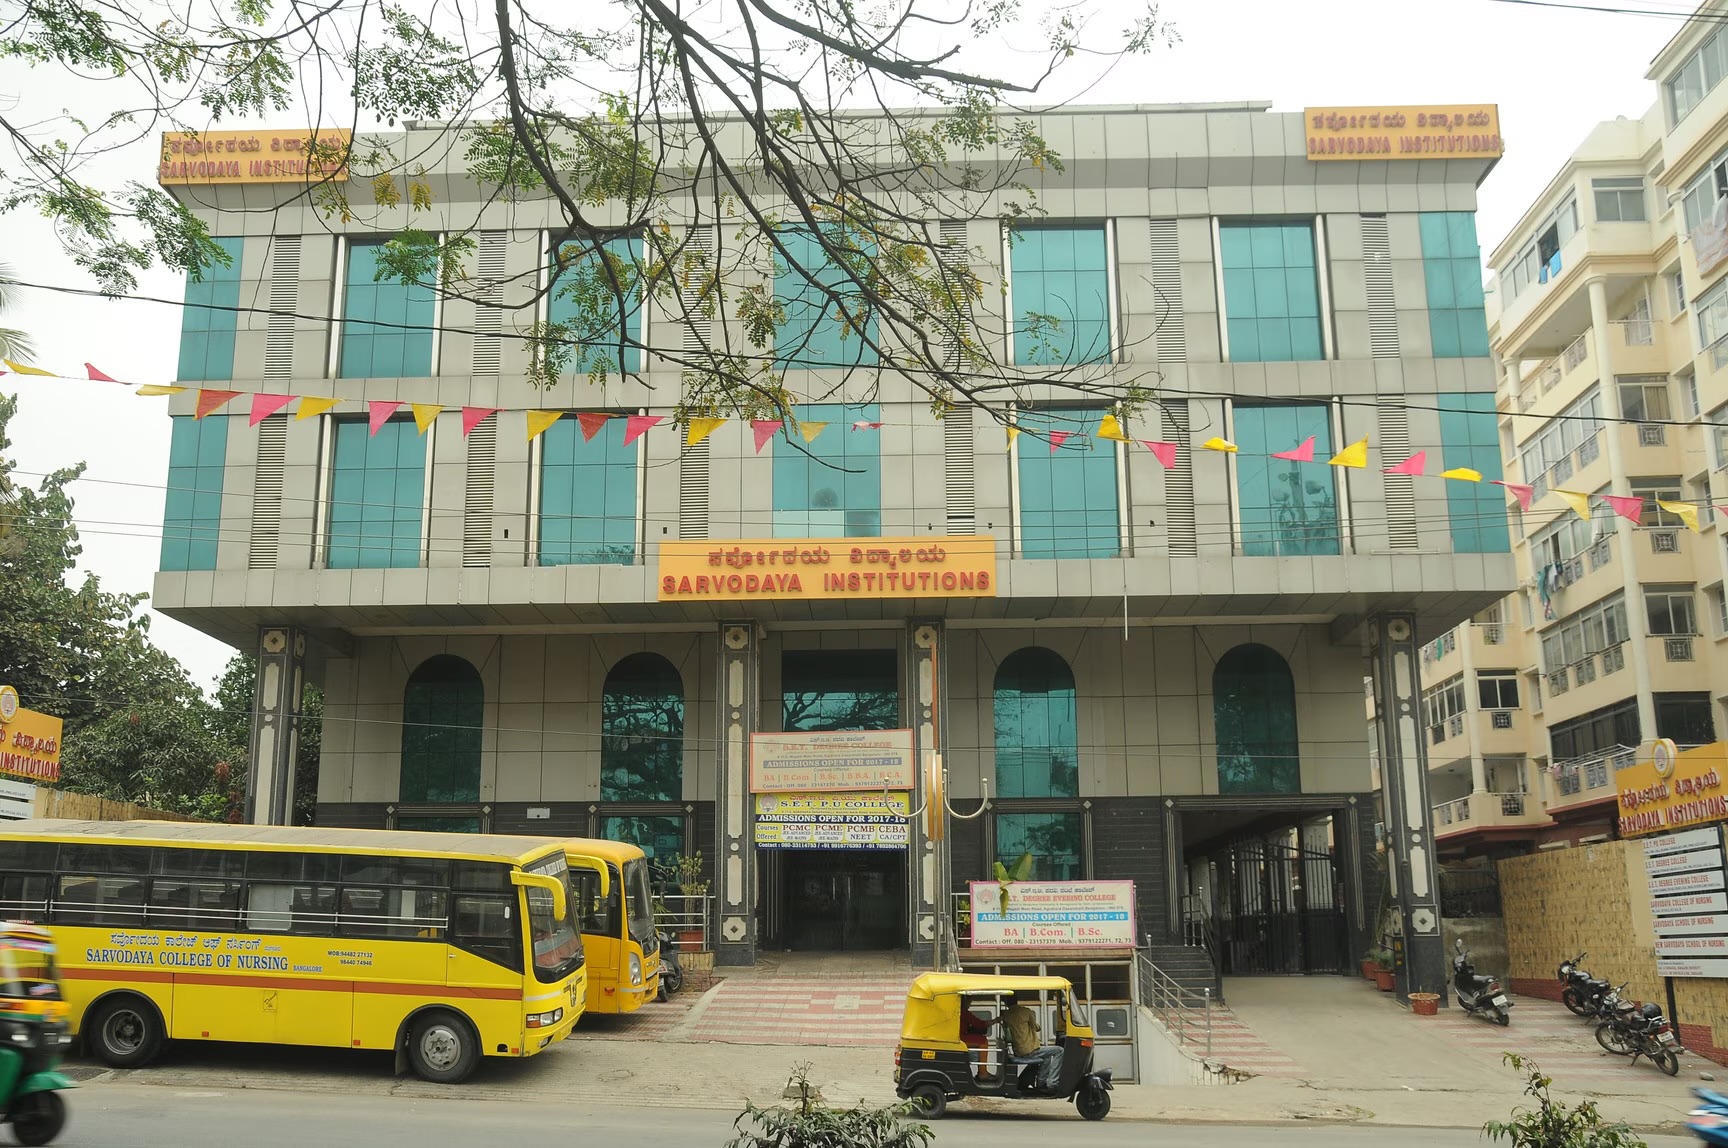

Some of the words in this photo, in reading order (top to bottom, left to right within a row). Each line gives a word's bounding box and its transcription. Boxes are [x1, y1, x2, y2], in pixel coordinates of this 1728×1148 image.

[1308, 136, 1391, 154] SARVODAYA
[1399, 135, 1500, 153] INSTITUTIONS
[161, 161, 240, 178] SARVODAYA
[662, 574, 802, 594] SARVODAYA
[824, 571, 990, 592] INSTITUTIONS
[1618, 810, 1664, 832] SARVODAYA
[1665, 795, 1728, 824] INSTITUTIONS
[1078, 928, 1103, 936] B.Sc.
[166, 934, 198, 947] ಕಾಲೇಜ್
[203, 936, 221, 950] ಆಫ್
[86, 948, 154, 964] SARVODAYA
[160, 952, 212, 967] COLLEGE
[217, 954, 232, 968] OF
[237, 955, 288, 970] NURSING
